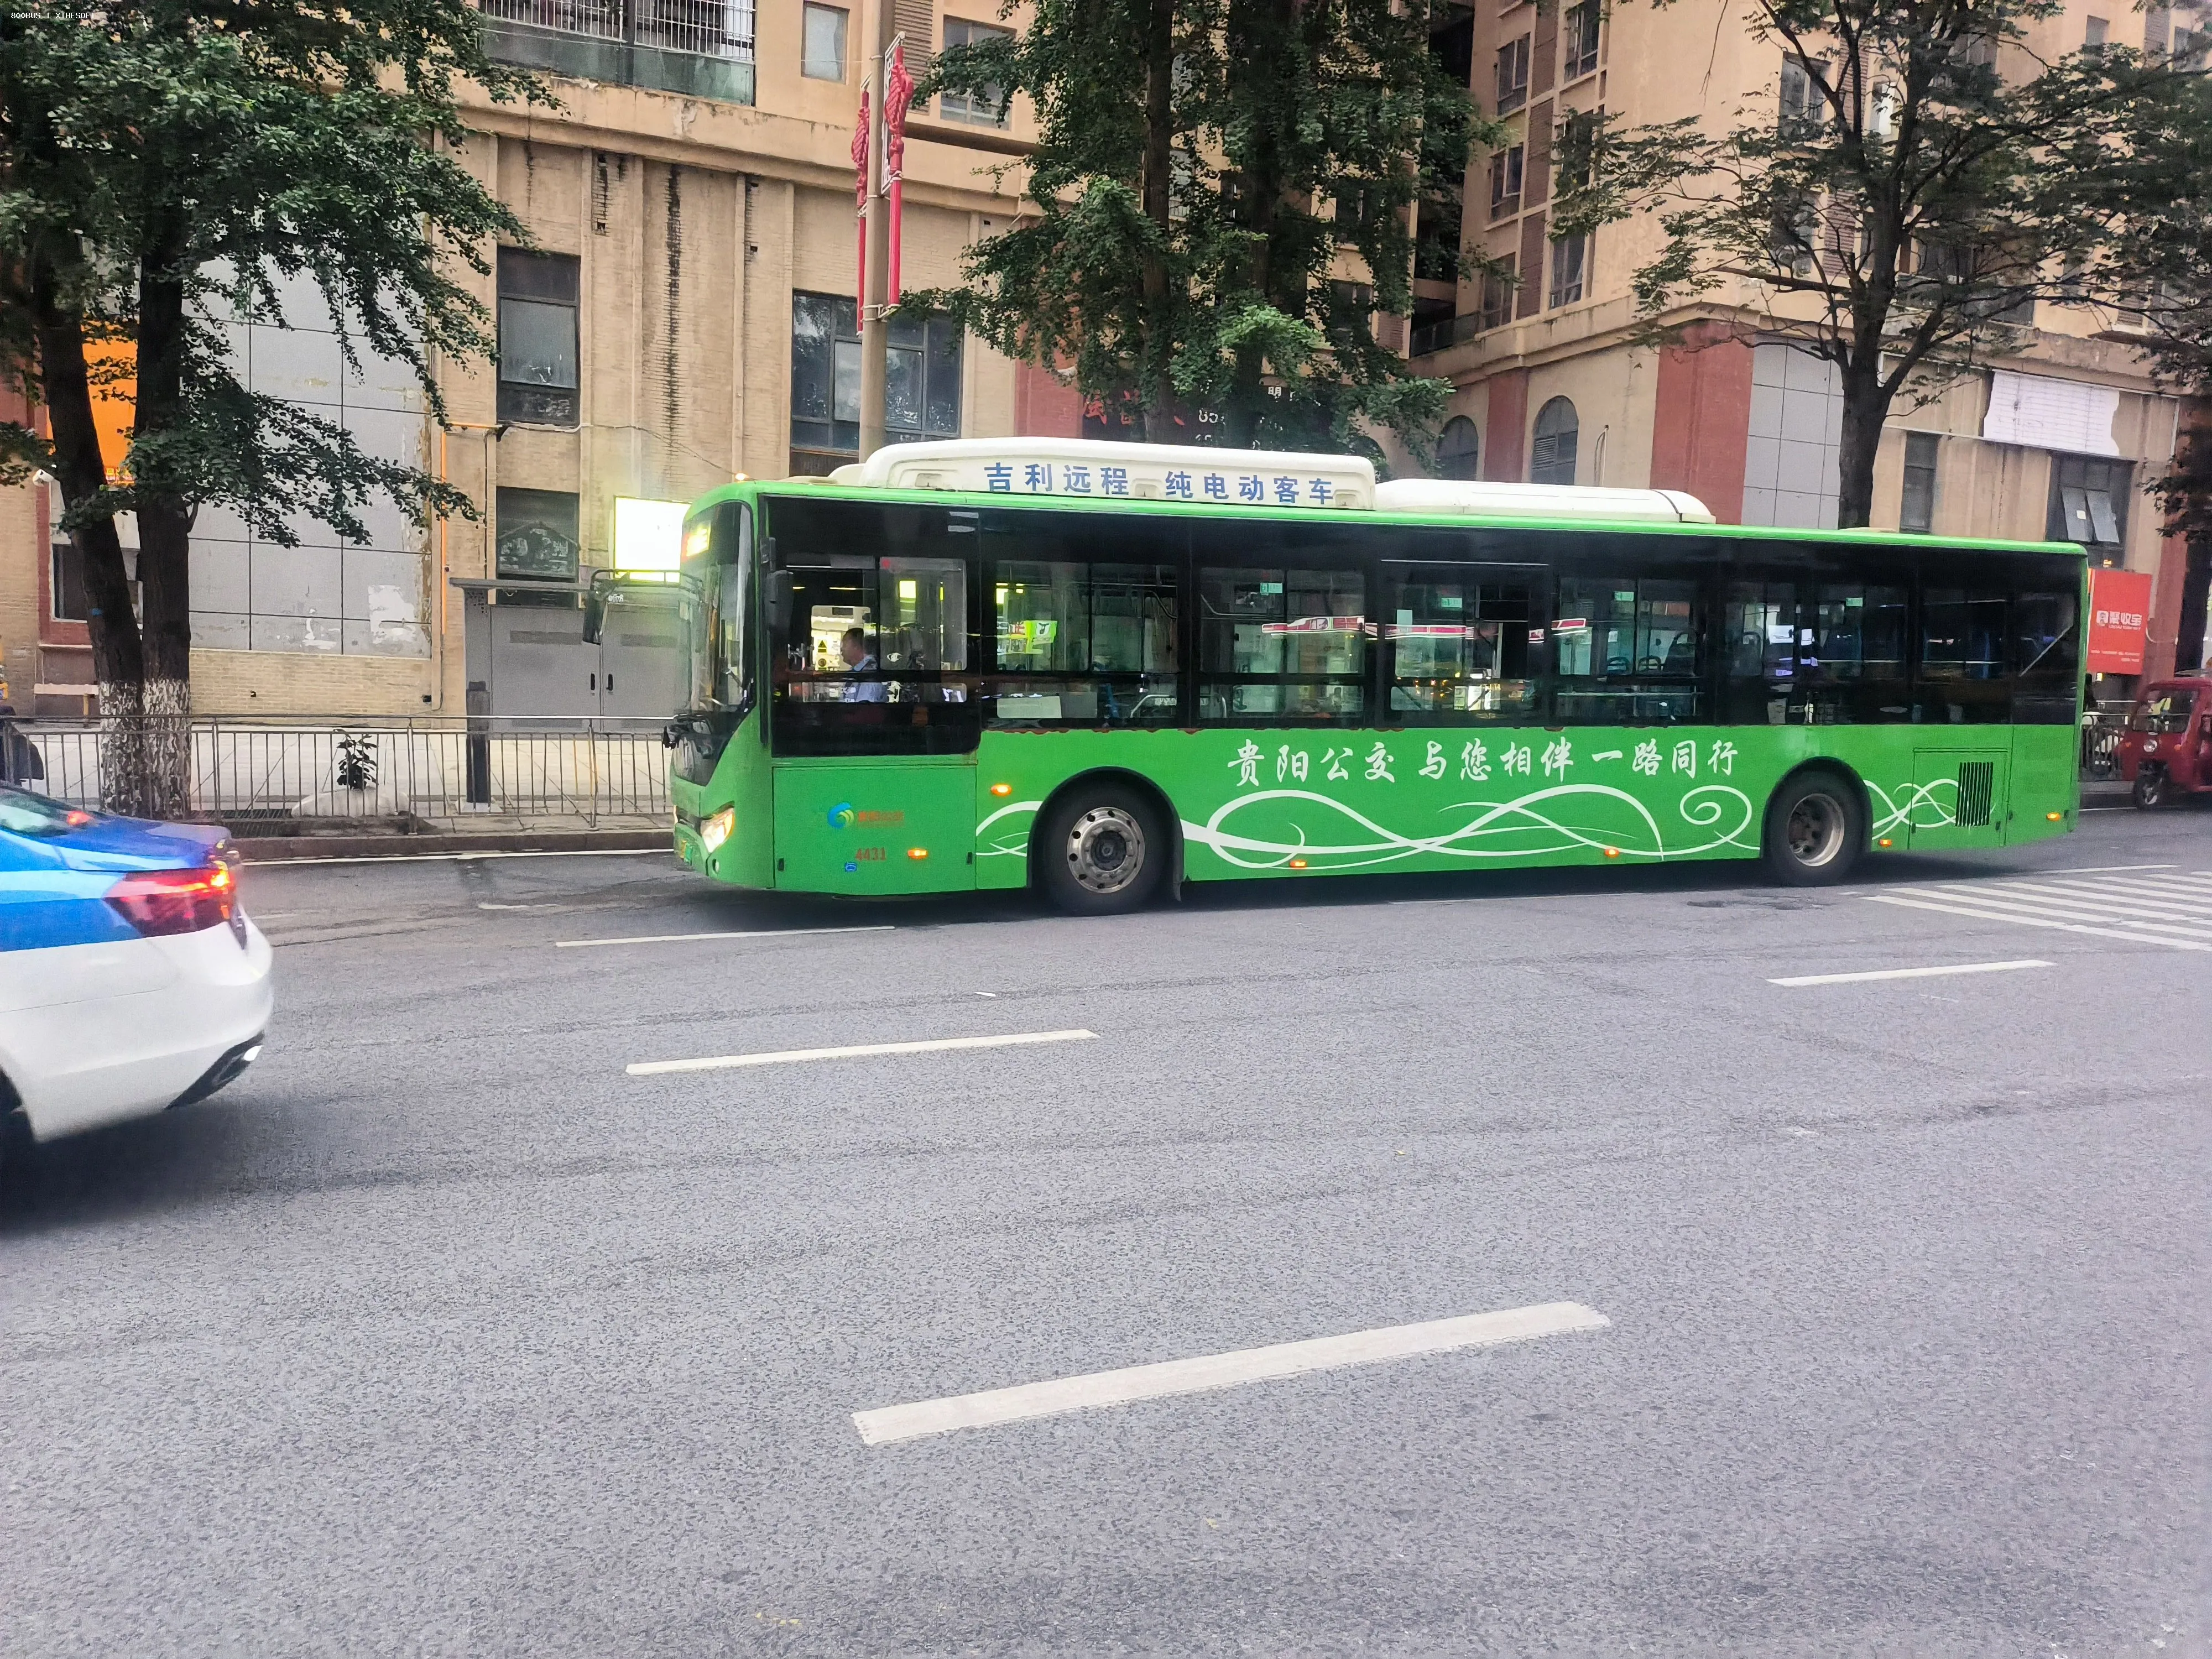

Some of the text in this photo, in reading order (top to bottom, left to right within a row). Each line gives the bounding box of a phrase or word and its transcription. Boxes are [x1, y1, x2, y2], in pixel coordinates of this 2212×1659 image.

[984, 462, 1334, 505] 吉利远程 纯电动客车
[1227, 736, 1739, 787] 贵阳公交 与您相伴 一路同行
[855, 847, 886, 861] 4431
